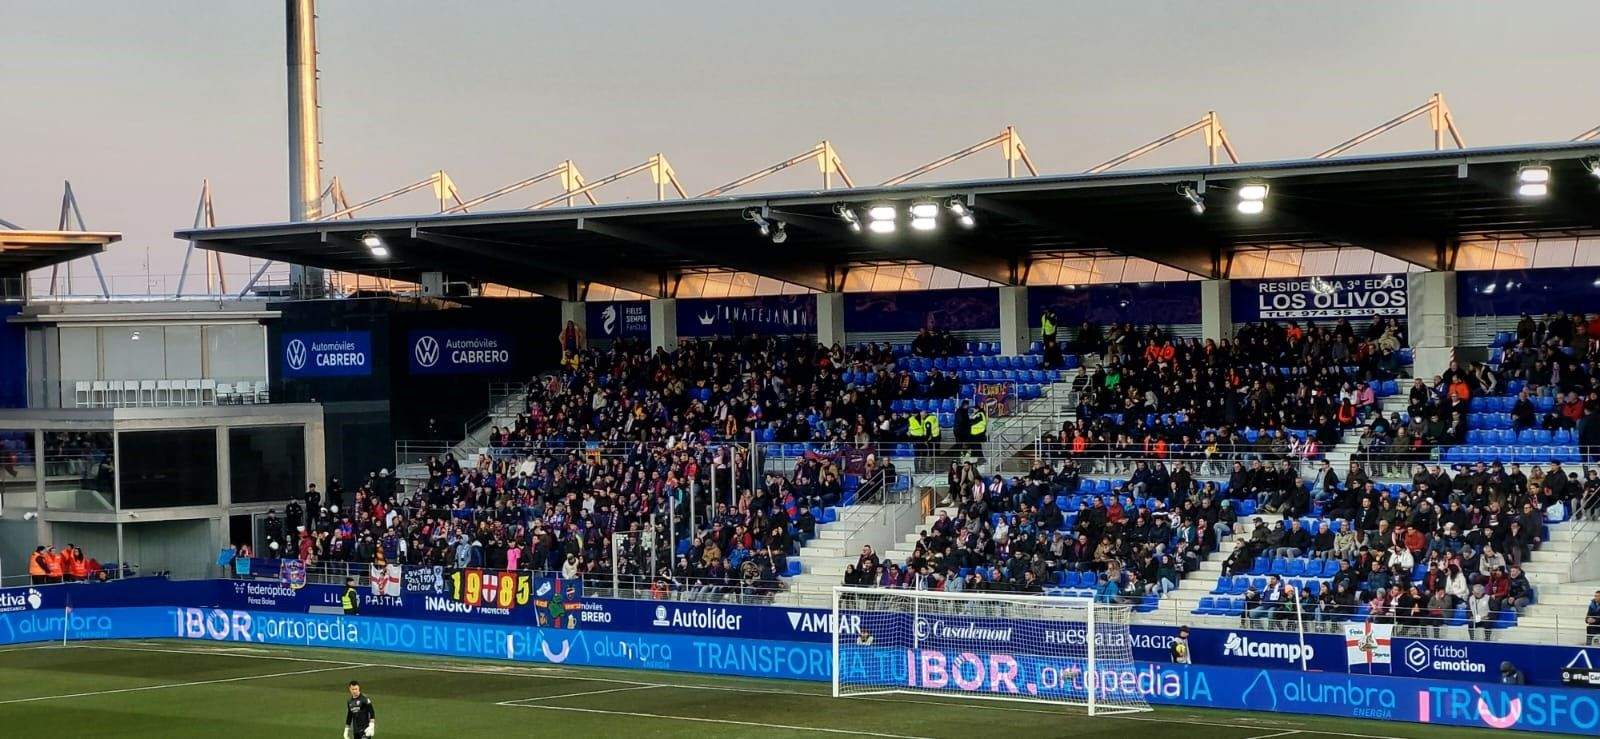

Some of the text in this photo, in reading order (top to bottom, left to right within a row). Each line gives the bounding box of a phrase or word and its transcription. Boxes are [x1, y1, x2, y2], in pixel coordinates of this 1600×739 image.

[1364, 278, 1404, 290] EDAD
[1259, 290, 1406, 310] LOS OLIVOS
[311, 341, 355, 351] Automóviles
[446, 338, 497, 349] Automóviles
[316, 352, 365, 366] CABRERO
[451, 350, 509, 364] CABRERO
[247, 582, 296, 597] federópticos
[366, 595, 403, 607] PASTIA
[672, 608, 743, 630] Autolíder
[266, 617, 358, 646] ortopedia
[422, 625, 448, 650] EN
[933, 621, 1012, 642] Casademont
[1223, 632, 1315, 663] Alcampo
[1433, 644, 1468, 659] fútbol
[1433, 659, 1486, 673] emotion
[1041, 664, 1181, 700] ortopedia
[1283, 677, 1396, 708] alumbra
